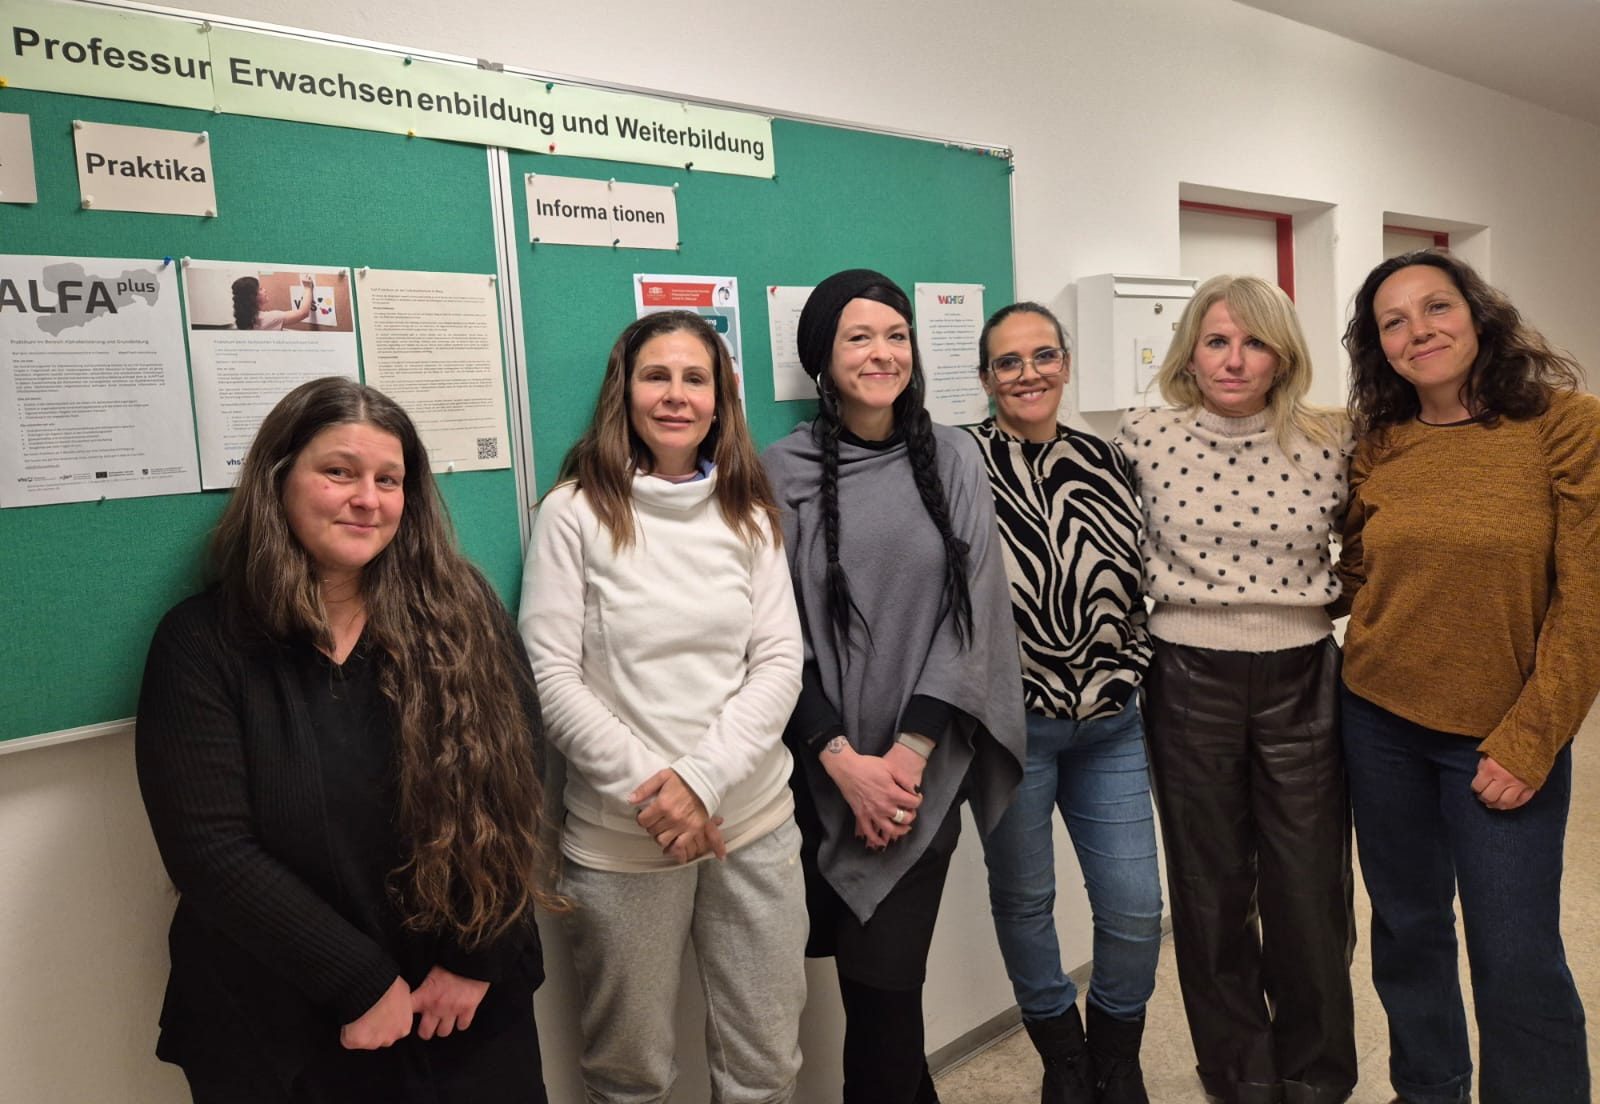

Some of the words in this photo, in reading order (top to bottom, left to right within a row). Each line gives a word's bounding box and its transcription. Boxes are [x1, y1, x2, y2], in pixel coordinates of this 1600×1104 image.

[13, 26, 211, 80] Professur
[562, 114, 609, 136] und
[616, 116, 765, 160] Weiterbildung
[85, 152, 207, 183] Praktika
[0, 278, 118, 314] ALFA
[117, 278, 156, 295] plus
